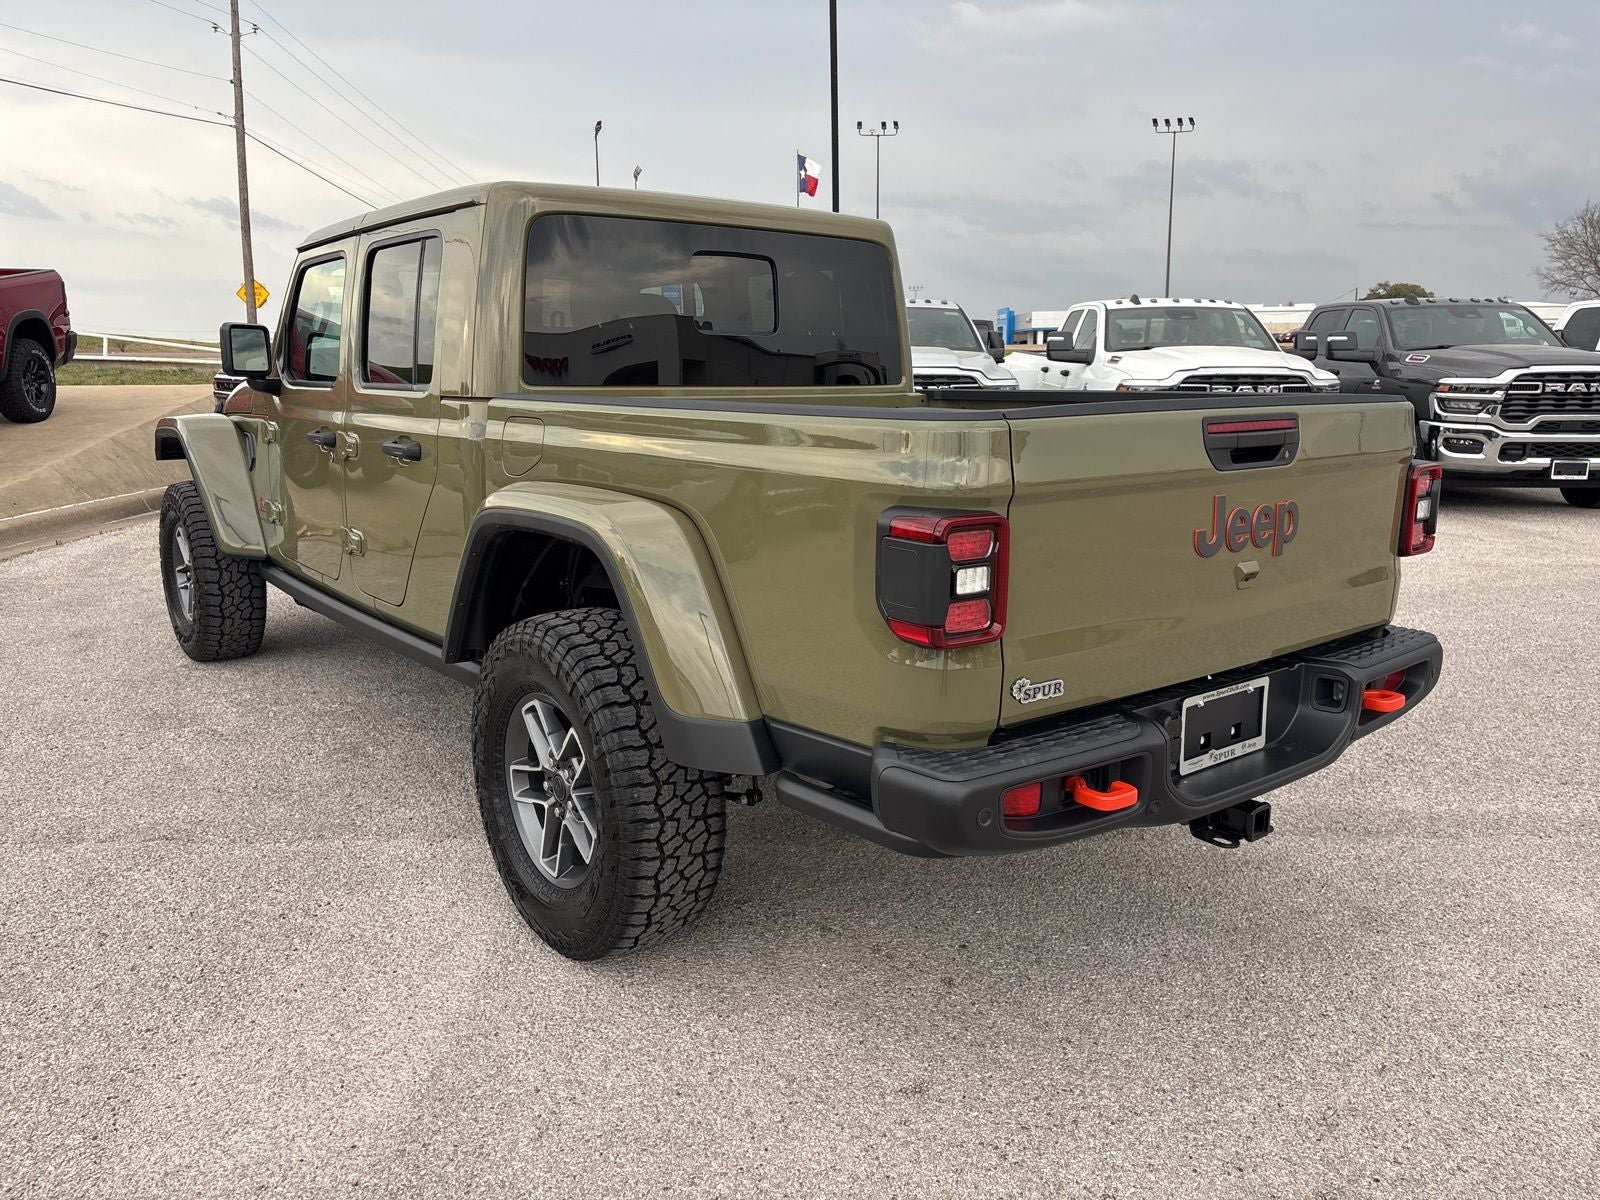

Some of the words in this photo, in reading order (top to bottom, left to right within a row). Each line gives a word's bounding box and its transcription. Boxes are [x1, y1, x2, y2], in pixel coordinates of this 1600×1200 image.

[1211, 385, 1280, 393] RAM
[1193, 494, 1300, 558] Jeep
[1023, 682, 1062, 700] SPUR
[1213, 749, 1236, 761] SPUR
